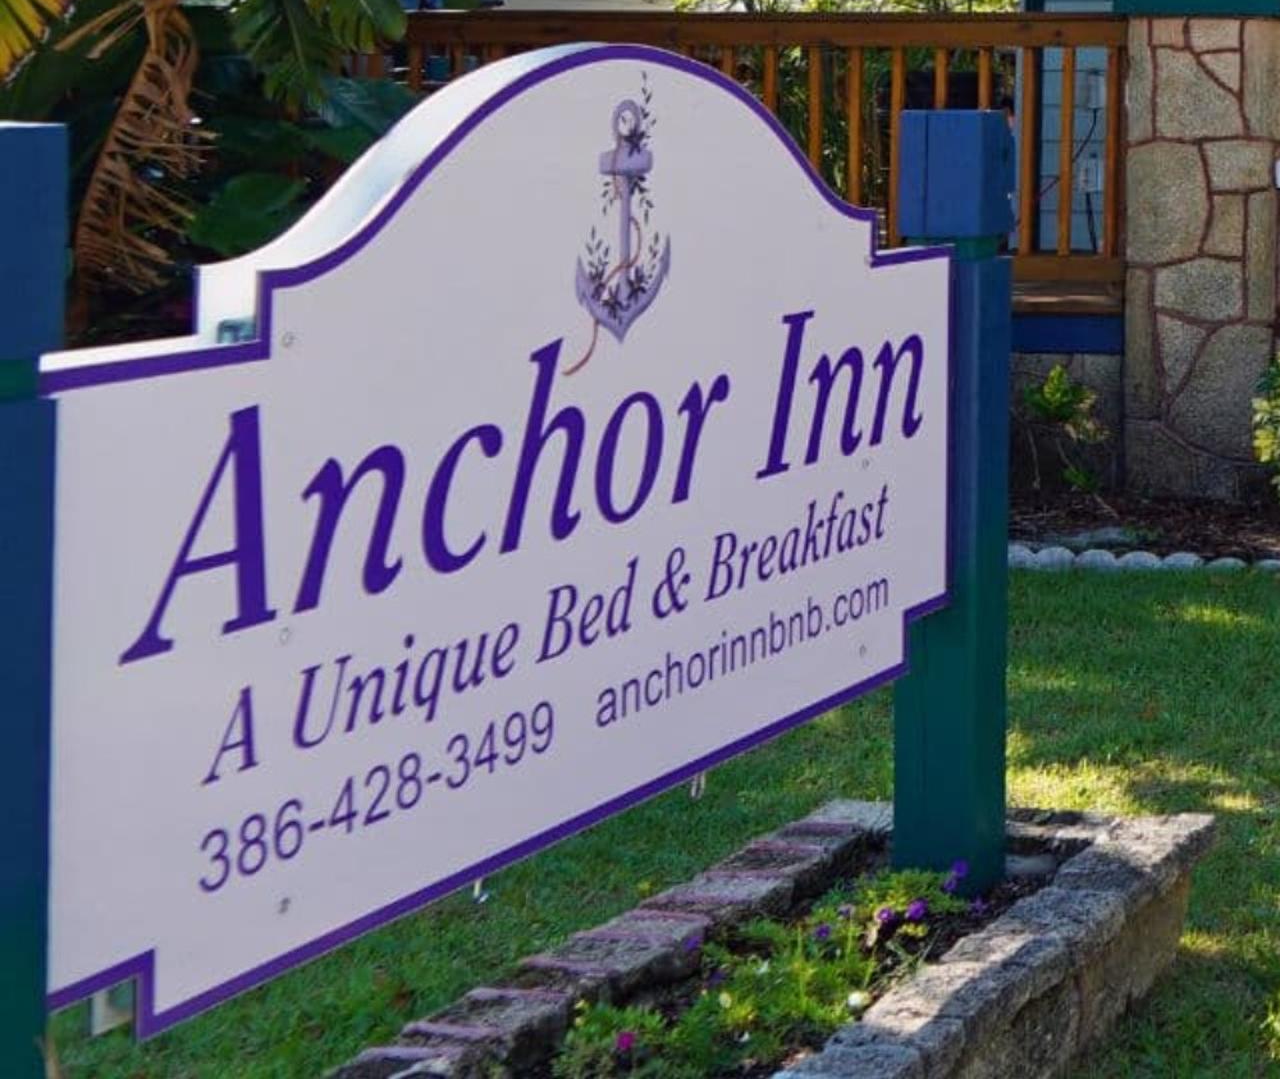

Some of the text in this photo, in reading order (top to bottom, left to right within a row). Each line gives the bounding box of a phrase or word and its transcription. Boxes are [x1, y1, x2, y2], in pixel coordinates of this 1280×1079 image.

[117, 308, 925, 667] Anchor Inn
[201, 483, 889, 786] A Unique Bed & Breakfast
[198, 576, 890, 894] 386-428-3499 anchorinnbnb.com
